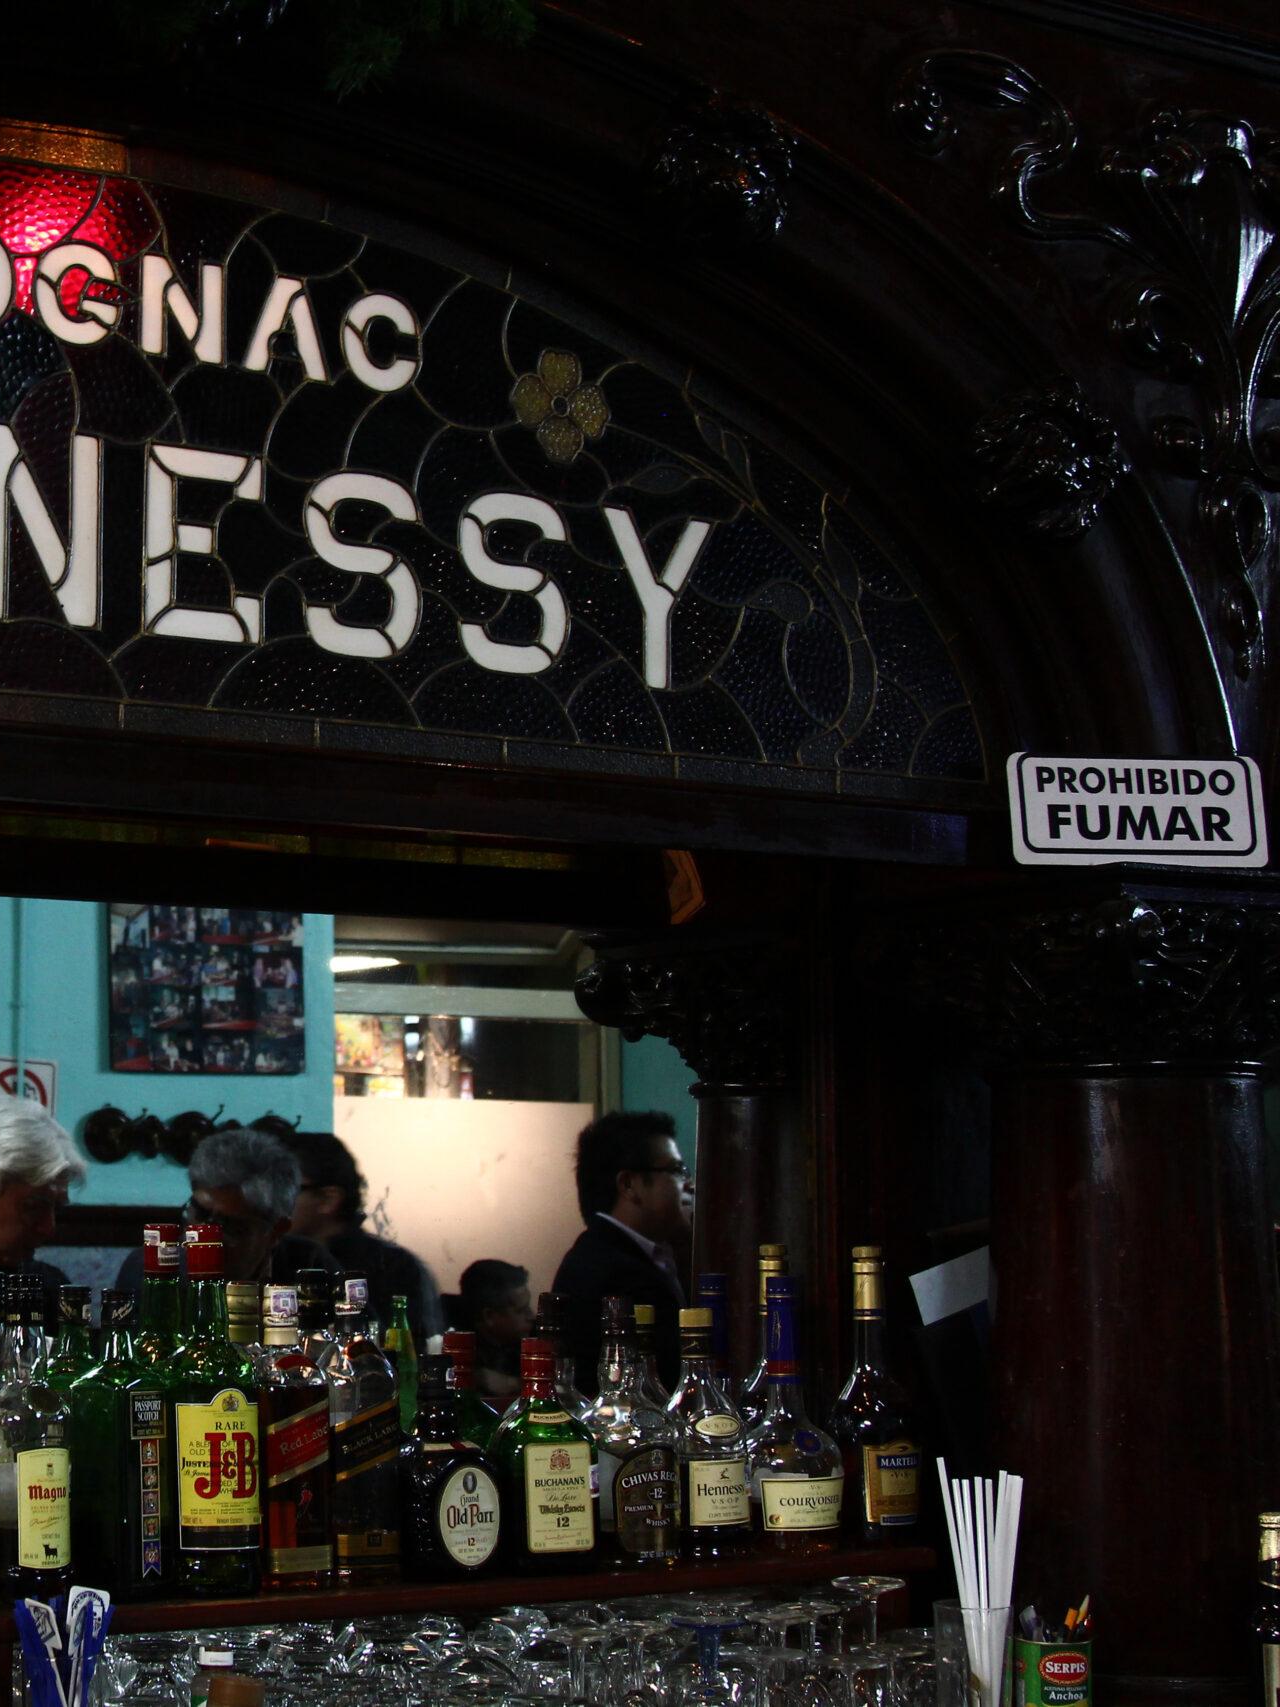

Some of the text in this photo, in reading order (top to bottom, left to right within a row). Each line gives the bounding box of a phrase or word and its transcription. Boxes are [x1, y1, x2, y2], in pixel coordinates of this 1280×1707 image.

[1035, 766, 1236, 796] PROHIBIDO
[1047, 804, 1234, 842] FUMAR
[134, 1400, 161, 1411] PASSPORT
[137, 1411, 159, 1421] SCOTCH
[215, 1421, 246, 1431] RARE
[194, 1432, 257, 1499] J&B
[535, 1476, 586, 1488] BUCHANAN'S
[621, 1470, 677, 1489] CHIVAS REG
[28, 1485, 66, 1502] Magno
[460, 1493, 480, 1507] Grand
[624, 1504, 654, 1512] PREMIUM
[447, 1503, 494, 1529] Old Parr
[556, 1516, 570, 1528] 12
[467, 1537, 476, 1546] 12
[1045, 1661, 1086, 1674] SERPIS
[1049, 1691, 1084, 1701] Anchoa
